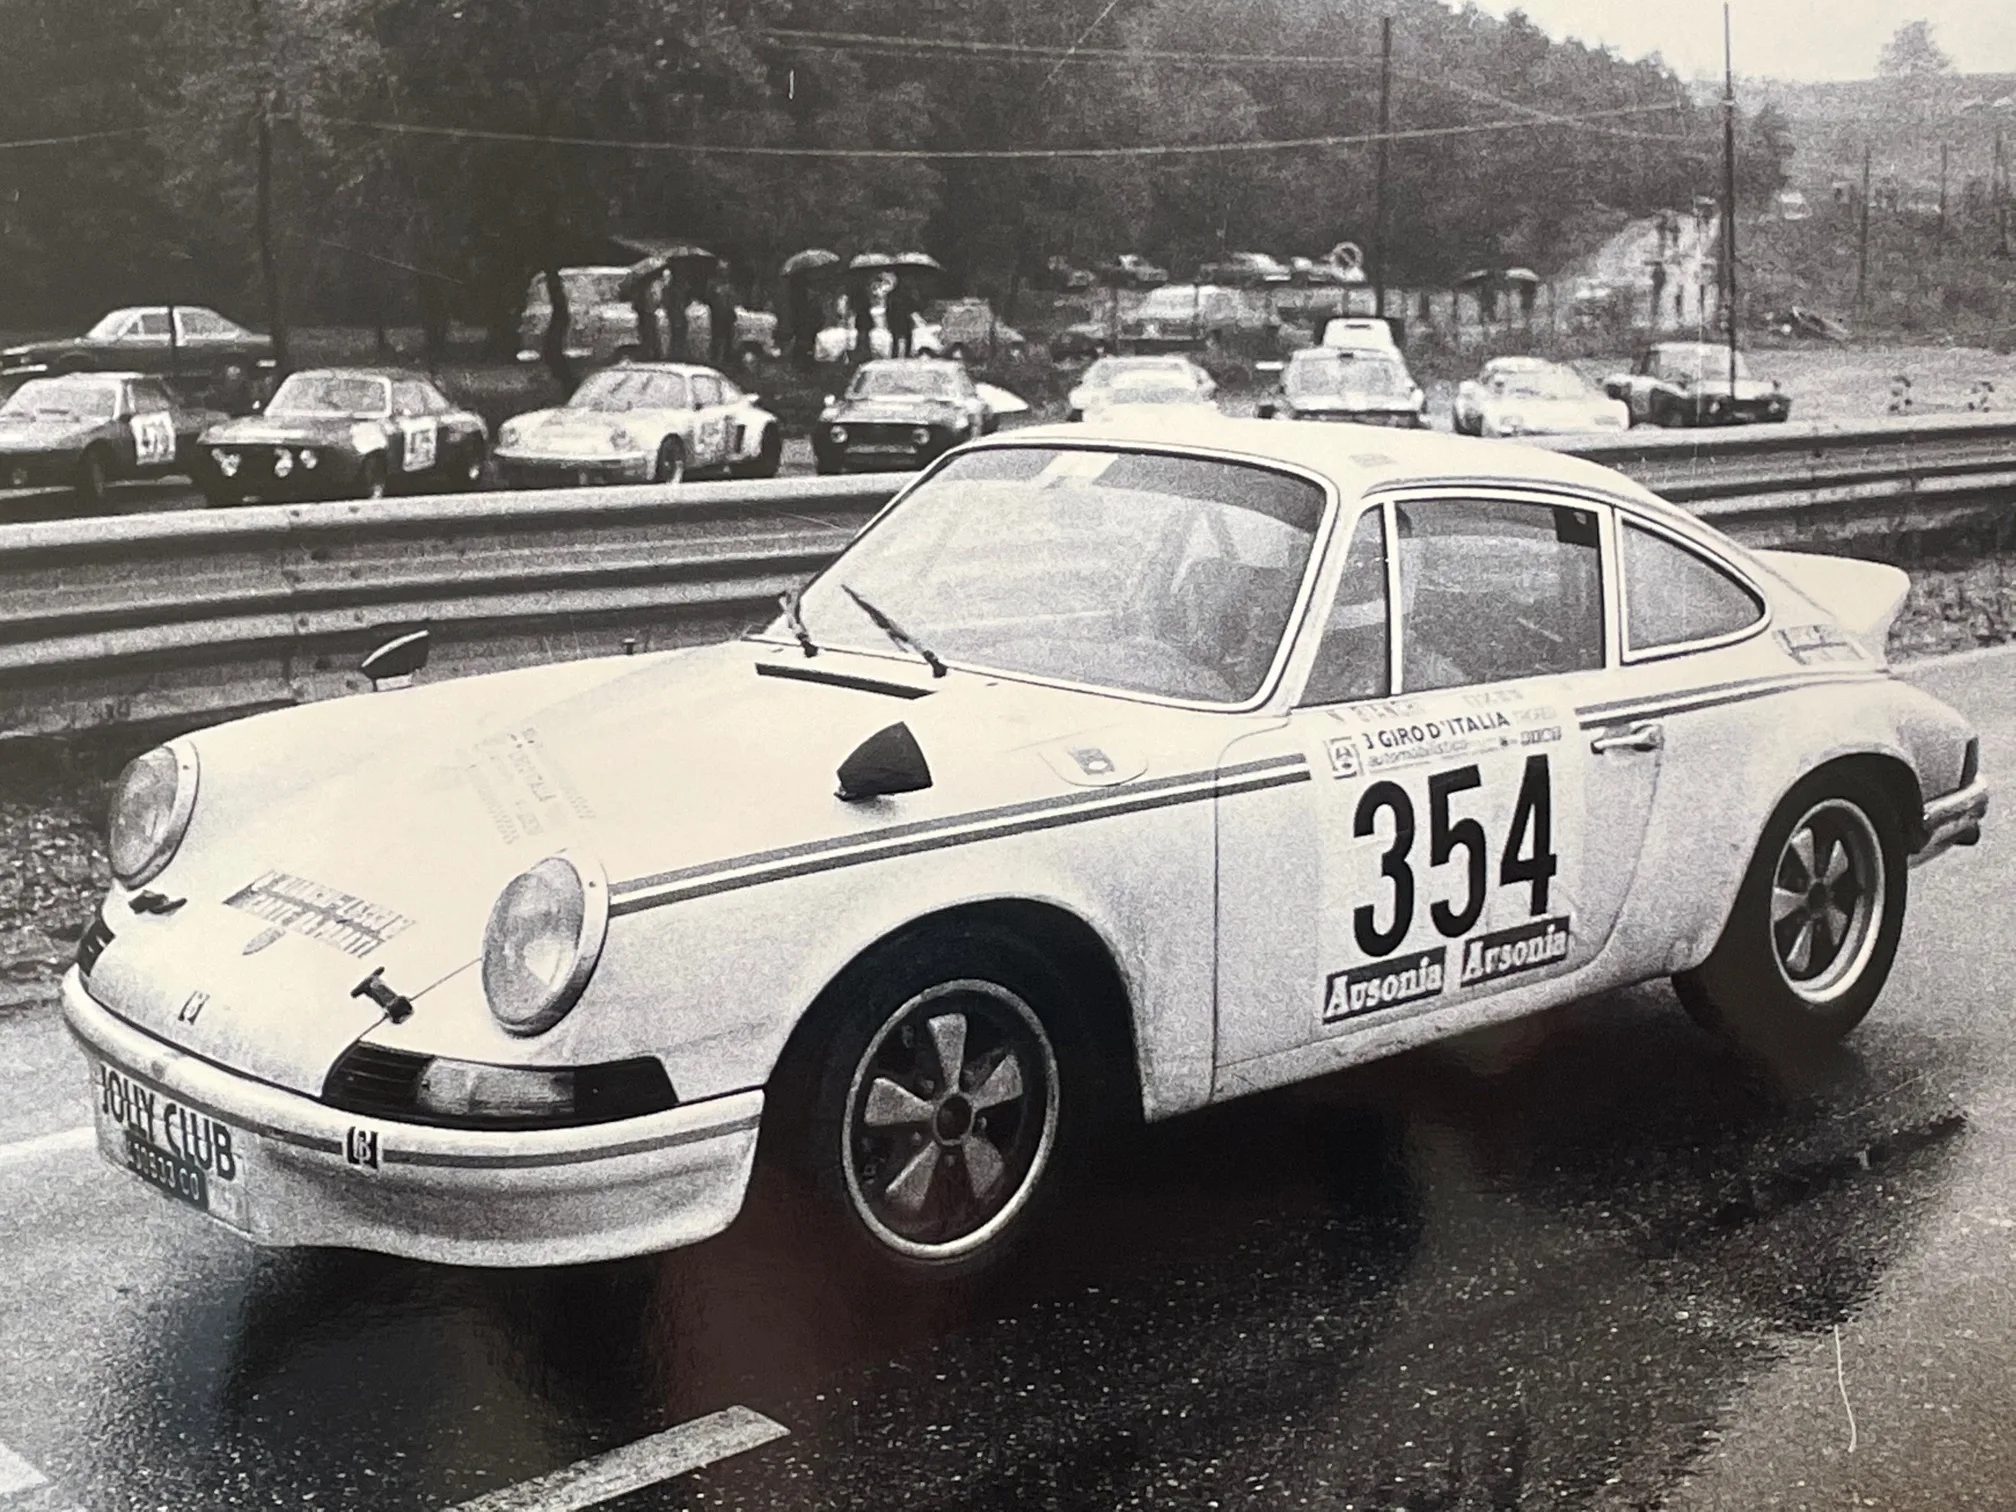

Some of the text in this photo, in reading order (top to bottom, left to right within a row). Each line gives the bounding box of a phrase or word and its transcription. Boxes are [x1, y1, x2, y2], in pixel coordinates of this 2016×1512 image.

[1377, 724, 1425, 748] GIRO
[1425, 711, 1511, 739] D'ITALIA
[1353, 753, 1558, 957] 354
[1323, 955, 1444, 1018] Ausonia
[99, 1063, 237, 1182] JOLLY CLUB
